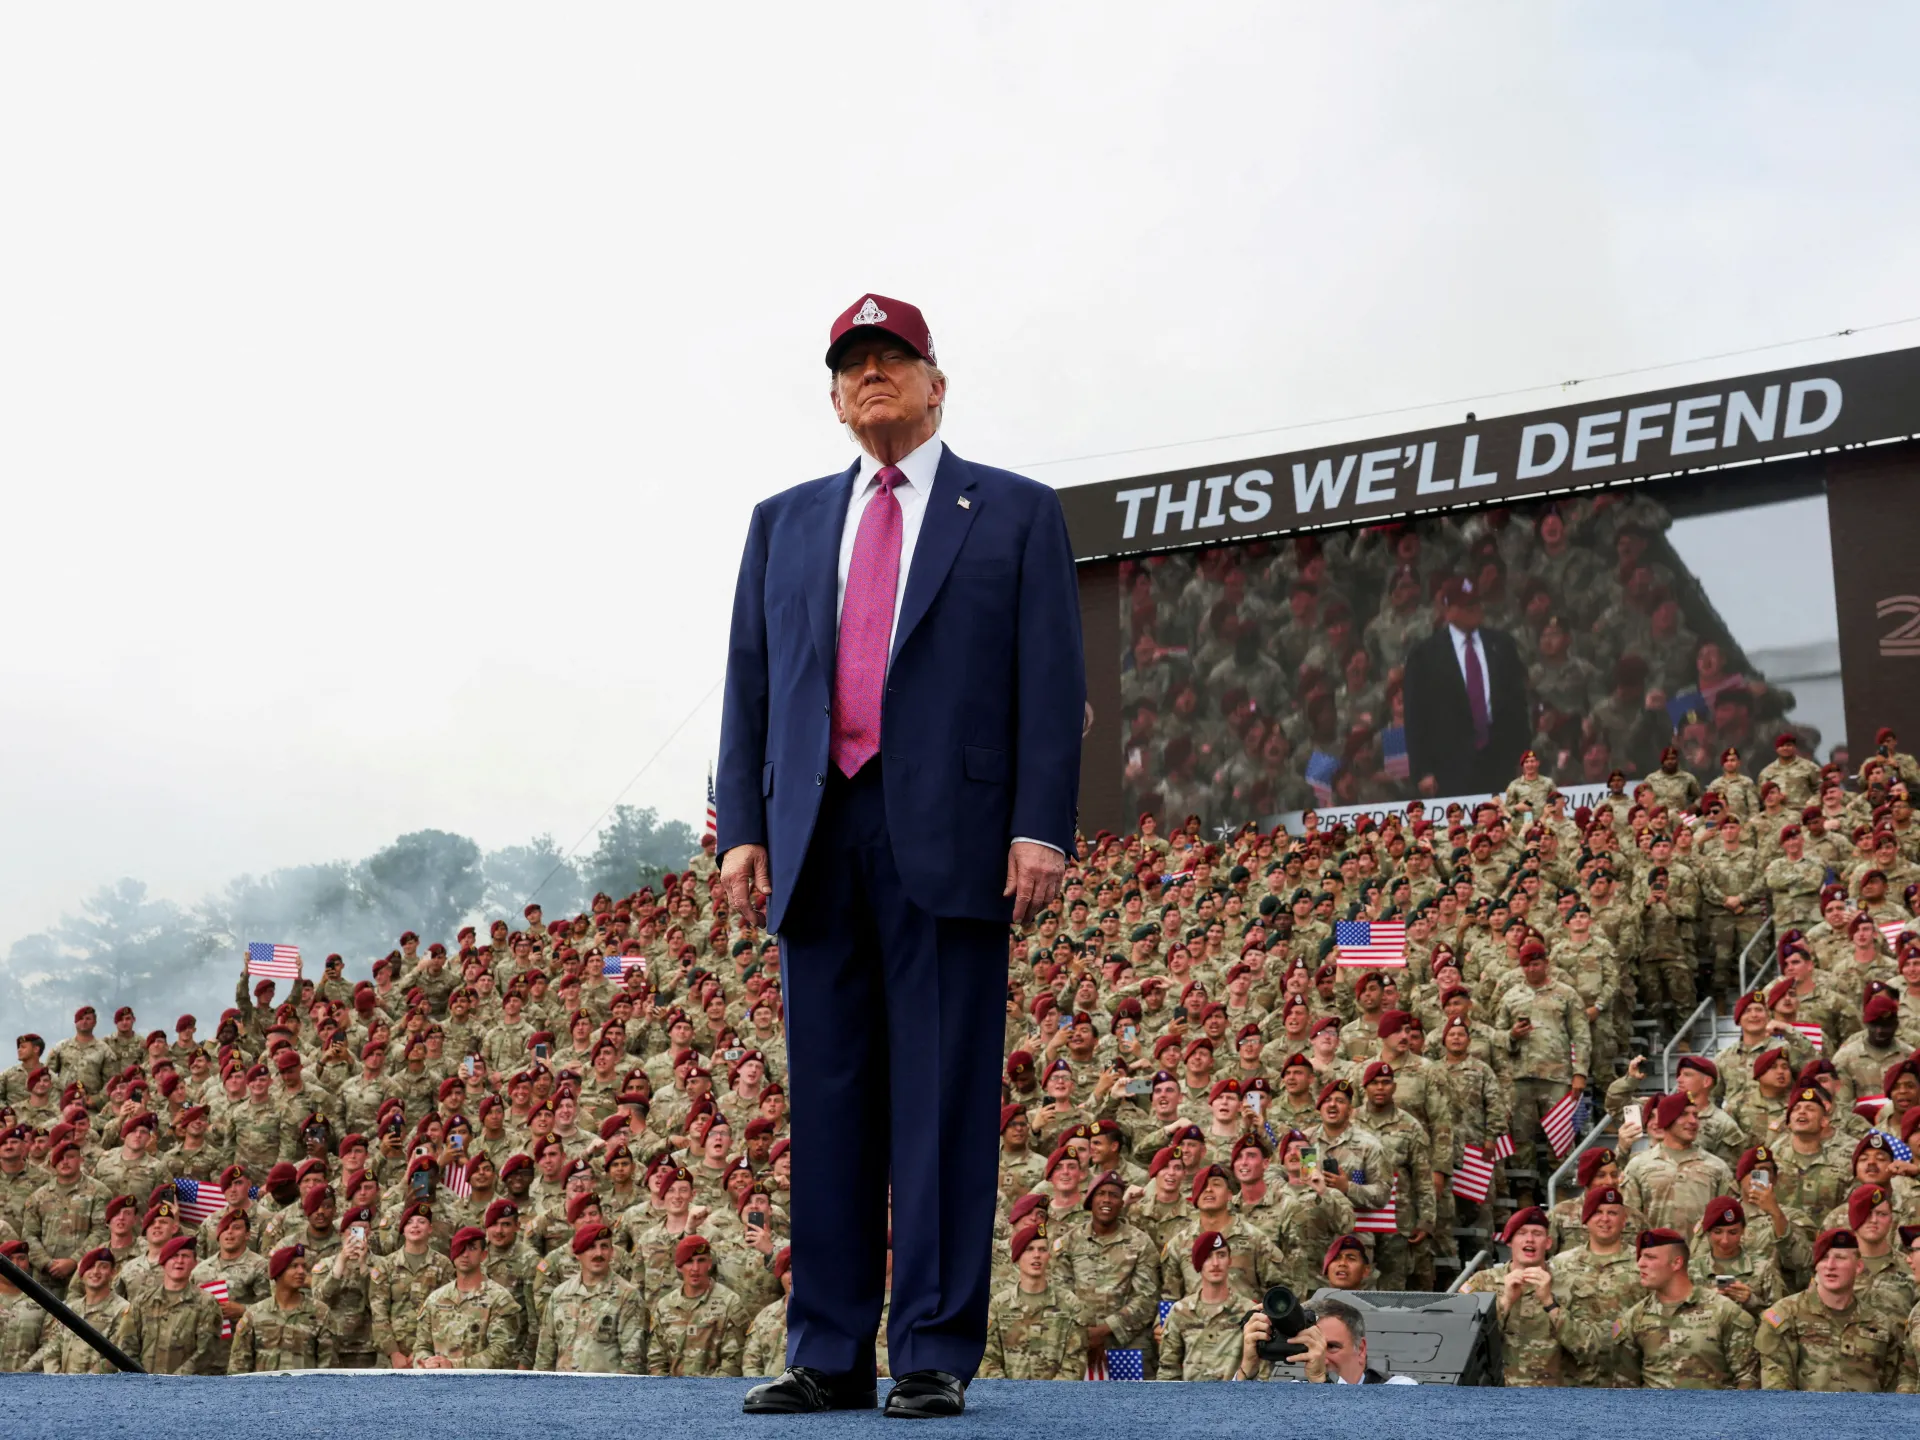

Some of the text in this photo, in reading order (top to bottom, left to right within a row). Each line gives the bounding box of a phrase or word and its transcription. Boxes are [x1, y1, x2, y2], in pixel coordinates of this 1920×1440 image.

[1115, 377, 1843, 539] THIS WE’LL DEFEND
[1317, 807, 1427, 831] PRESDN
